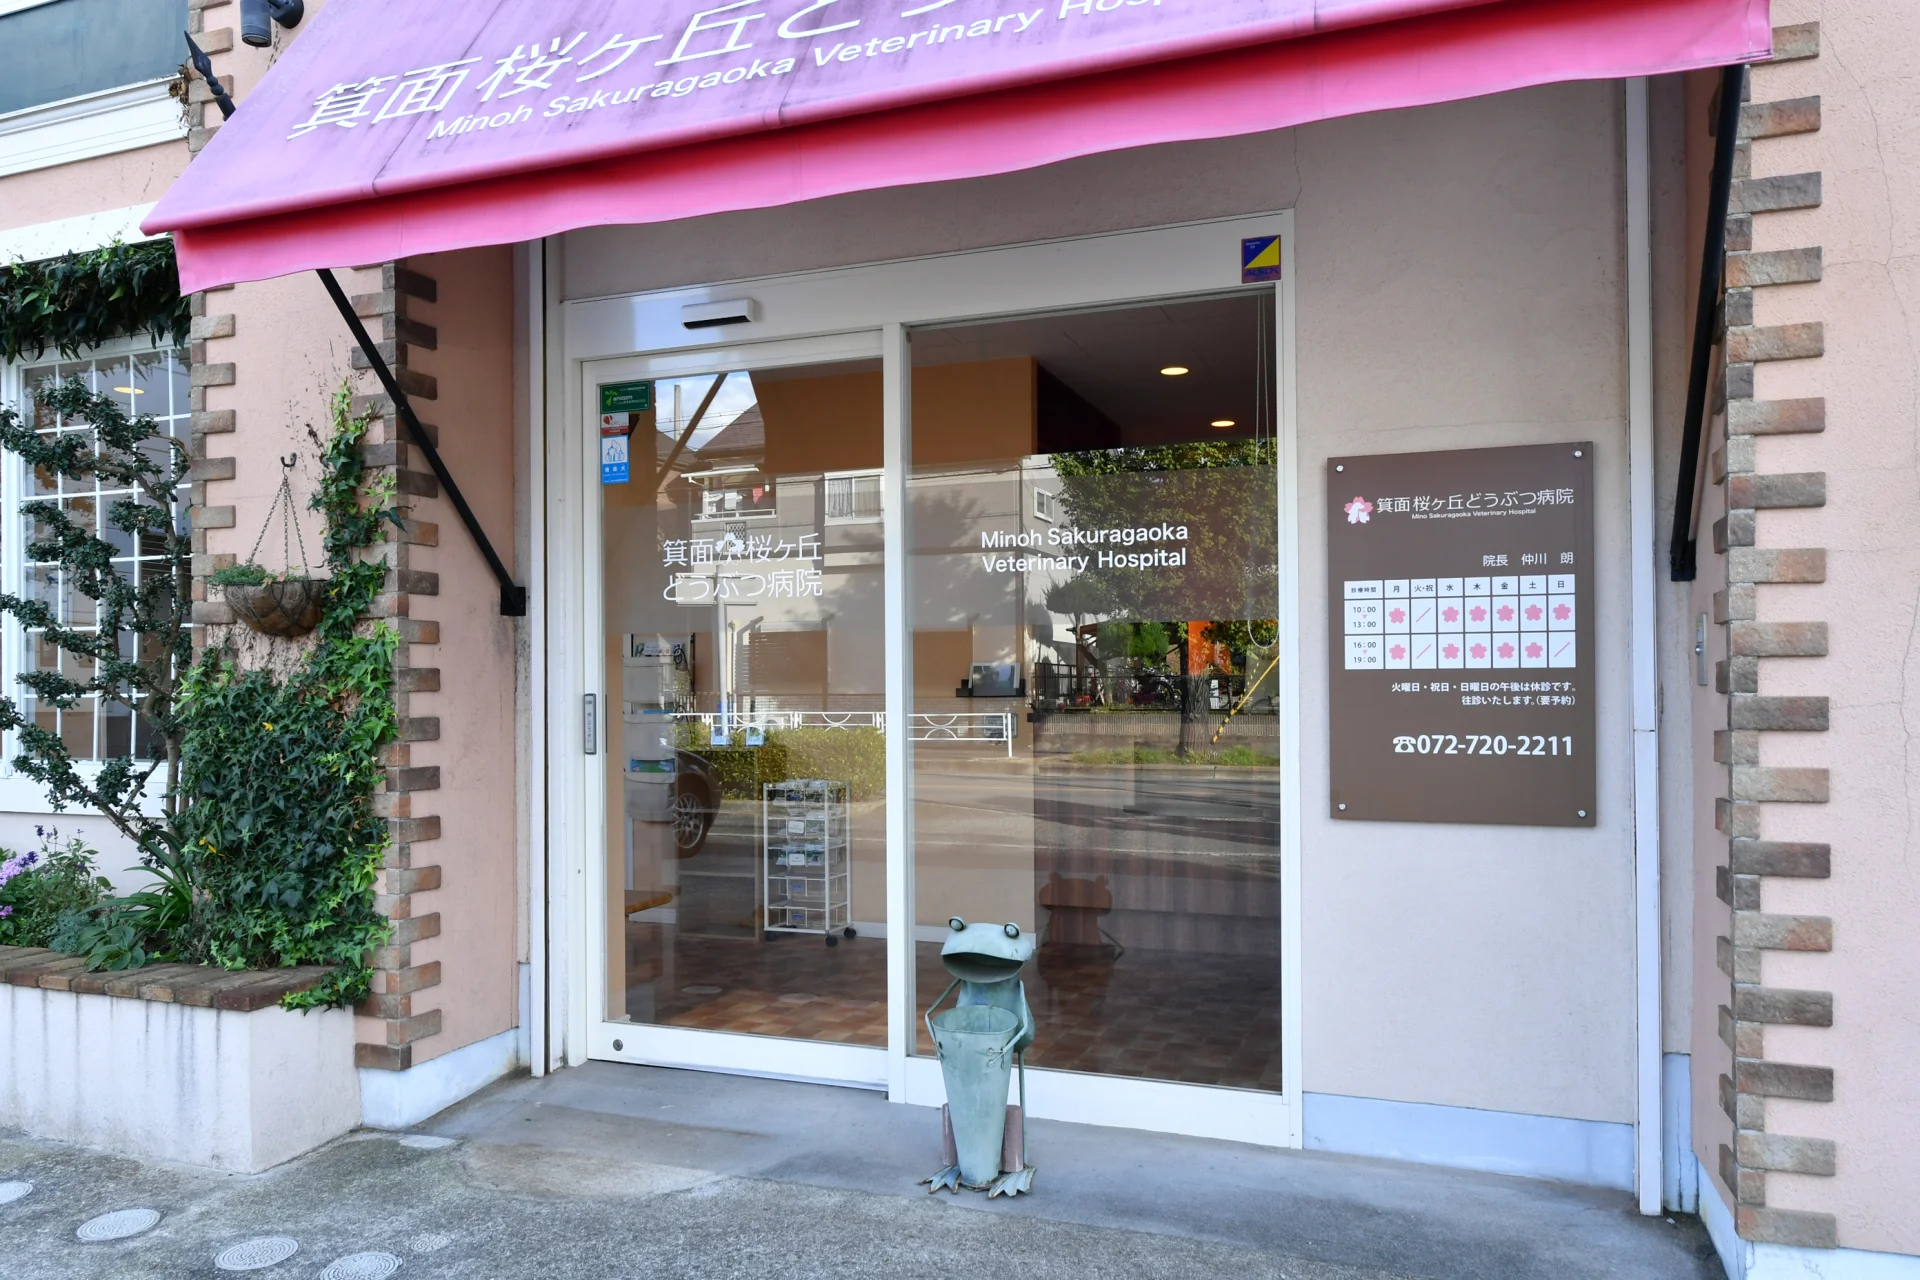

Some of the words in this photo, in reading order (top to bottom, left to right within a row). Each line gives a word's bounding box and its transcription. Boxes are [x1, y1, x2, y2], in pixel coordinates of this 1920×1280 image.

[427, 104, 533, 140] Minoh
[543, 56, 796, 118] Sakuragaoka
[814, 8, 1044, 66] Veterinary
[1428, 511, 1471, 520] Sakuragaoka
[1472, 509, 1507, 517] Veterinary
[1508, 508, 1537, 516] Hospital
[981, 529, 1042, 549] Minoh
[1047, 522, 1188, 546] Sakuragaoka
[982, 554, 1089, 573] Veterinary
[1098, 547, 1187, 571] Hospital
[1482, 554, 1508, 567] 院長
[1521, 552, 1547, 566] 仲川
[663, 567, 823, 601] どうぶつ病院
[1392, 585, 1400, 593] 月
[1445, 583, 1454, 591] 水
[1473, 582, 1482, 591] 木
[1500, 581, 1509, 590] 金
[1528, 581, 1537, 589] 土
[1557, 580, 1565, 588] 日
[1416, 734, 1572, 756] 072-720-2211
